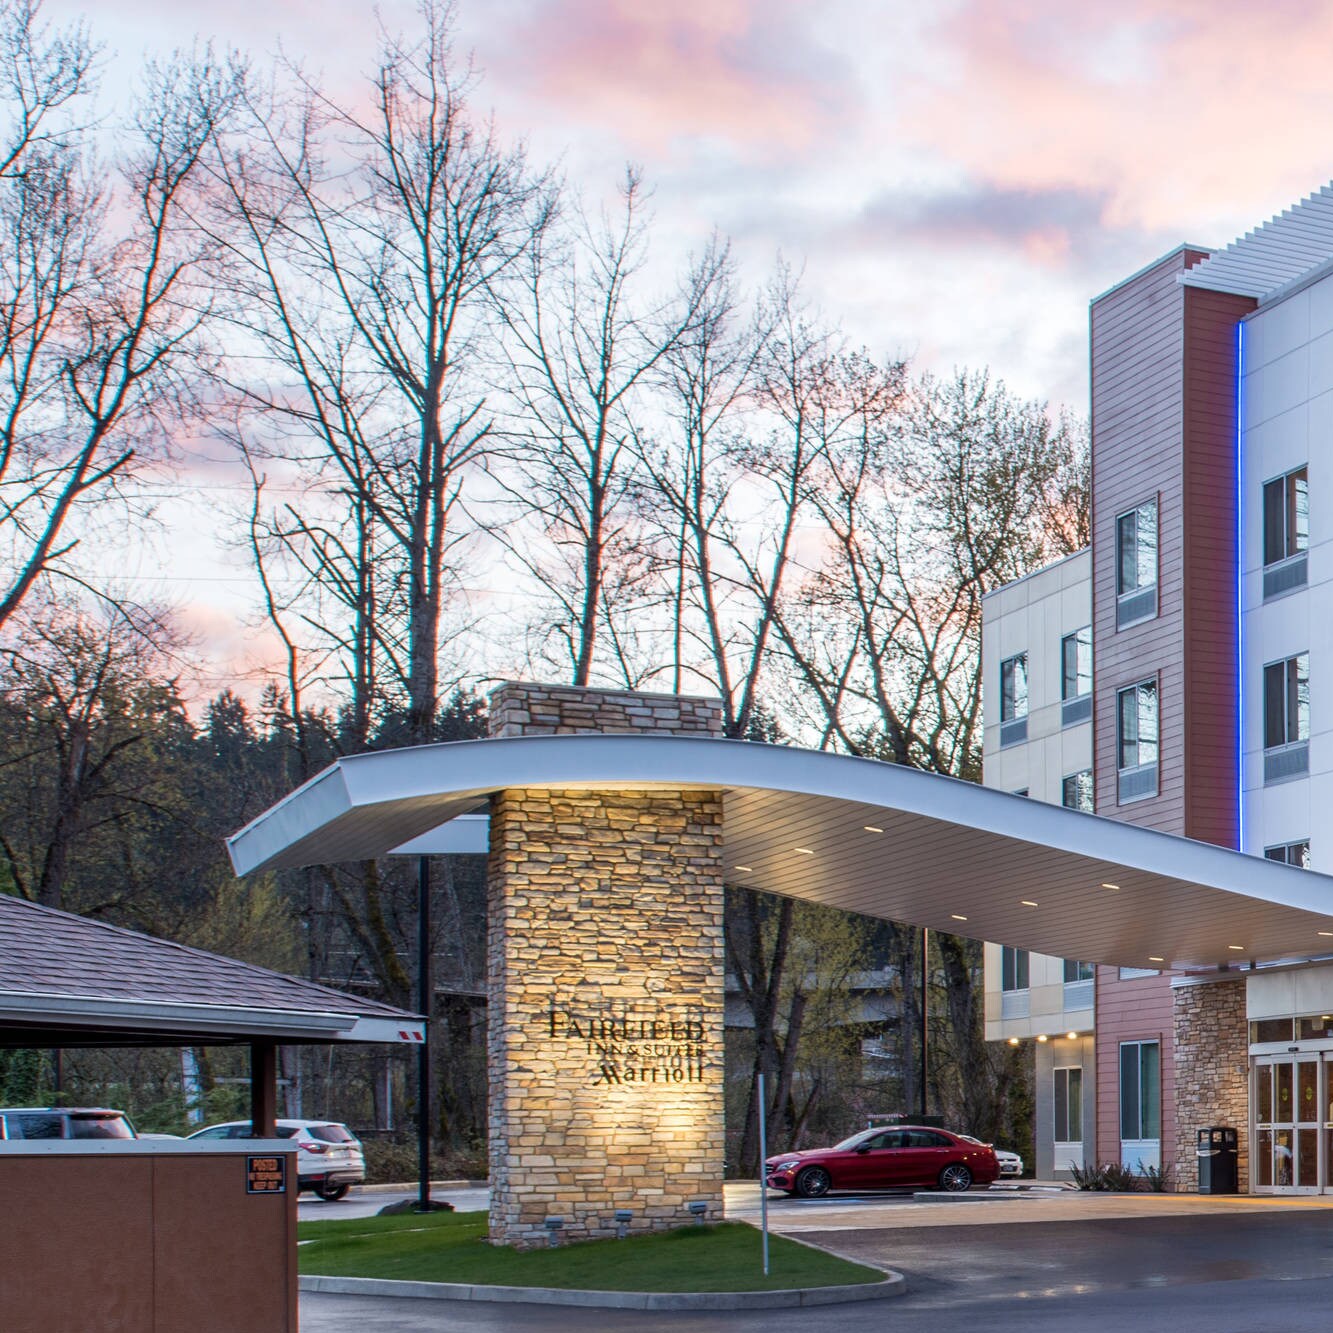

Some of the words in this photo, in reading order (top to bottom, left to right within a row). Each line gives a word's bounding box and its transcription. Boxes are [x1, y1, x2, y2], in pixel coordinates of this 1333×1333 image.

[549, 1011, 704, 1042] FAIRFIELD
[587, 1043, 626, 1055] INN
[591, 1064, 703, 1086] Marriott
